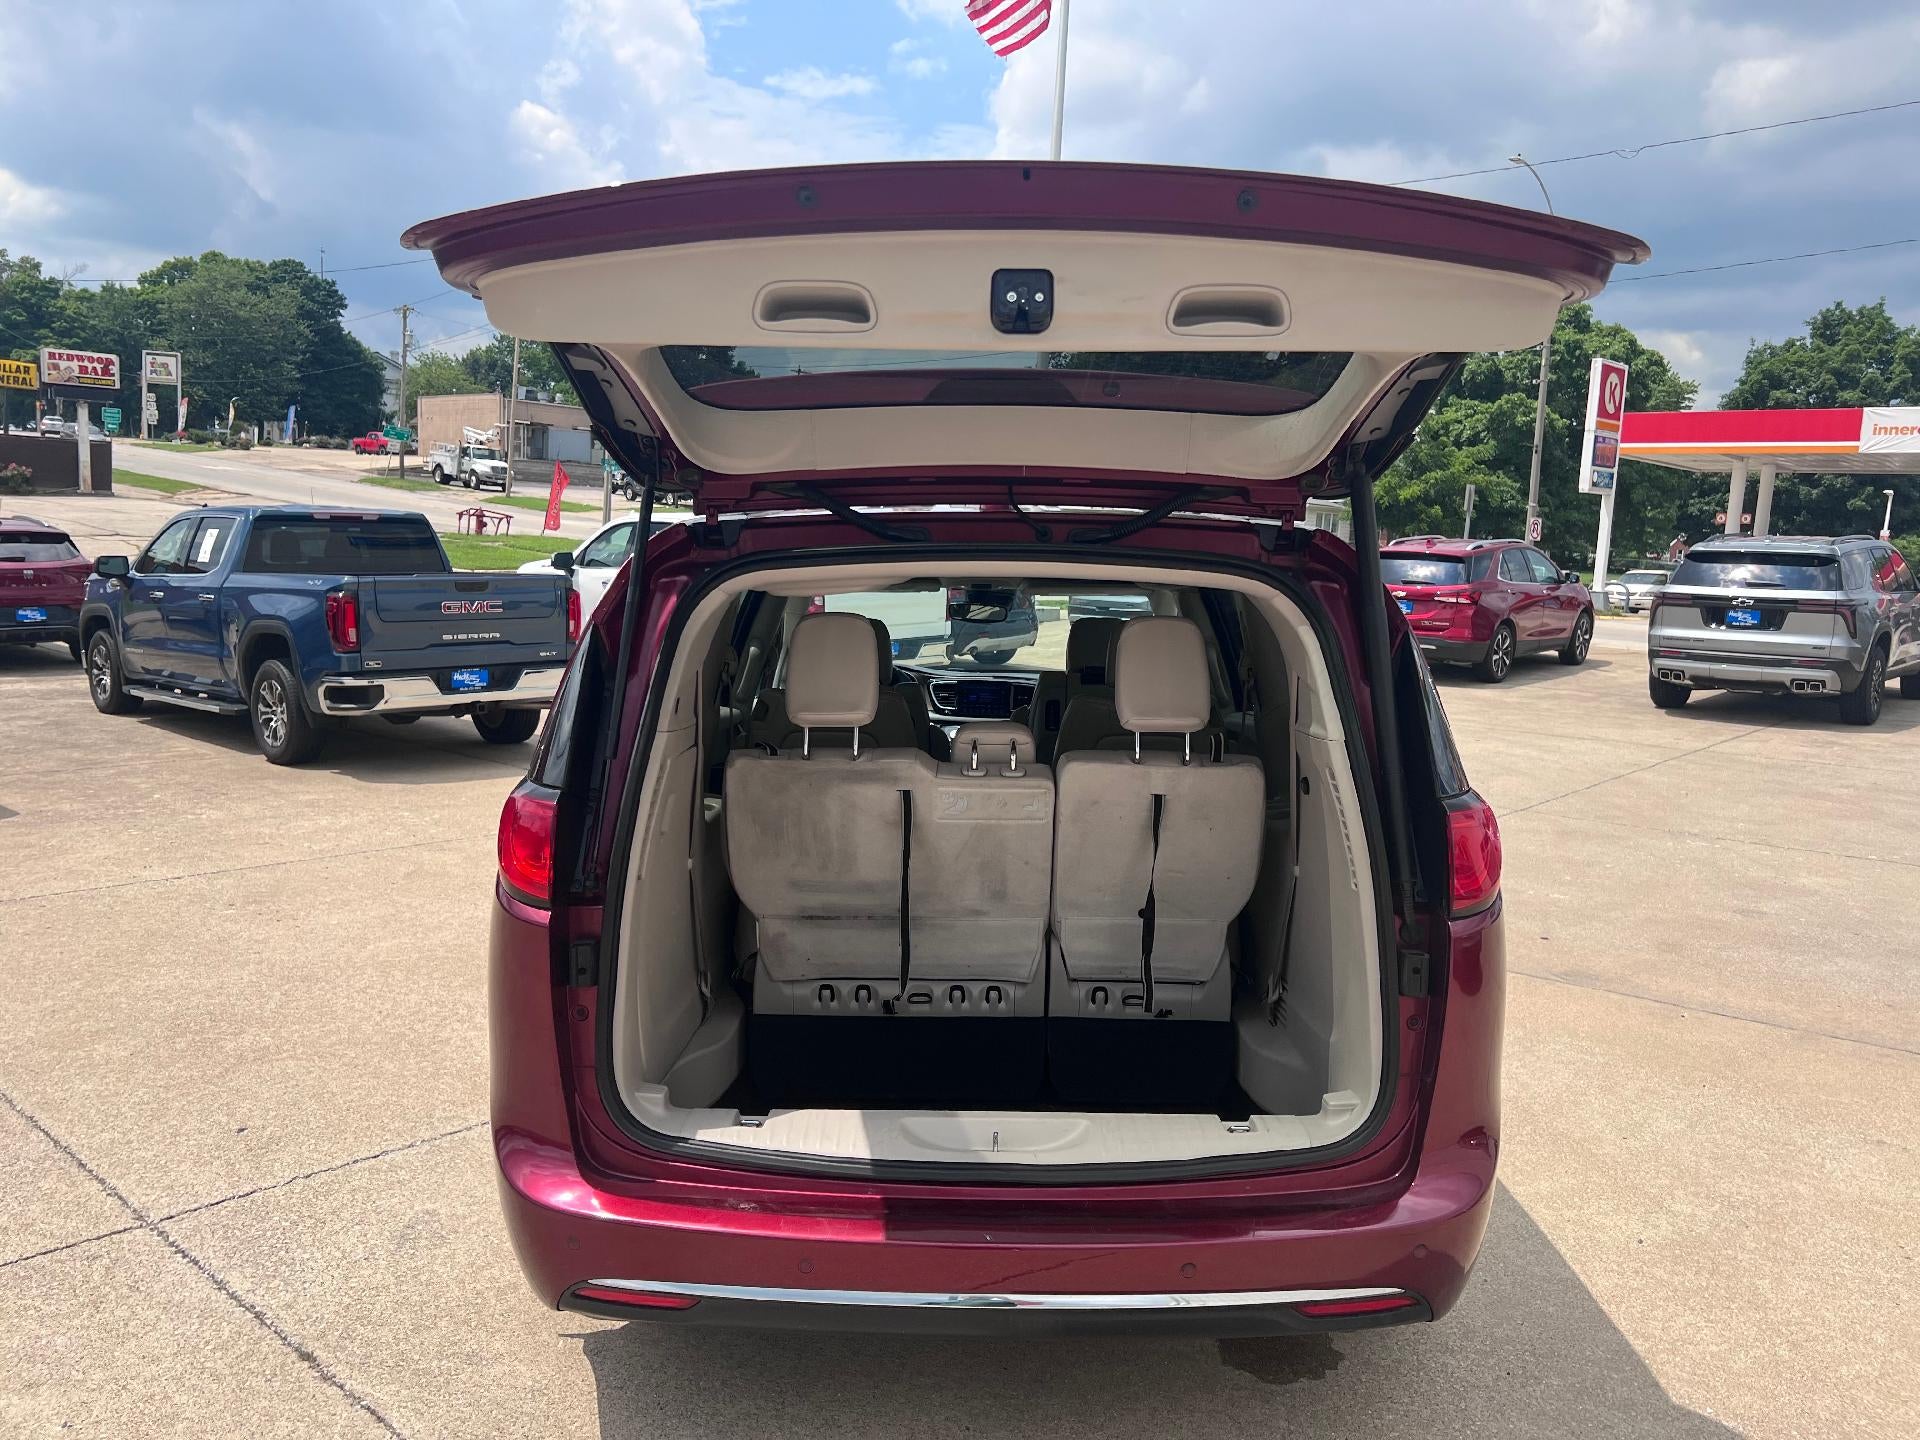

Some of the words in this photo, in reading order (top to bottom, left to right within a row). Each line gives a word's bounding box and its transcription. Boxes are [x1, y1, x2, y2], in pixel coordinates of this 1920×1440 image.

[1608, 381, 1618, 409] K
[1873, 424, 1920, 436] inner
[441, 600, 503, 614] GMC
[442, 632, 500, 640] SIERRA
